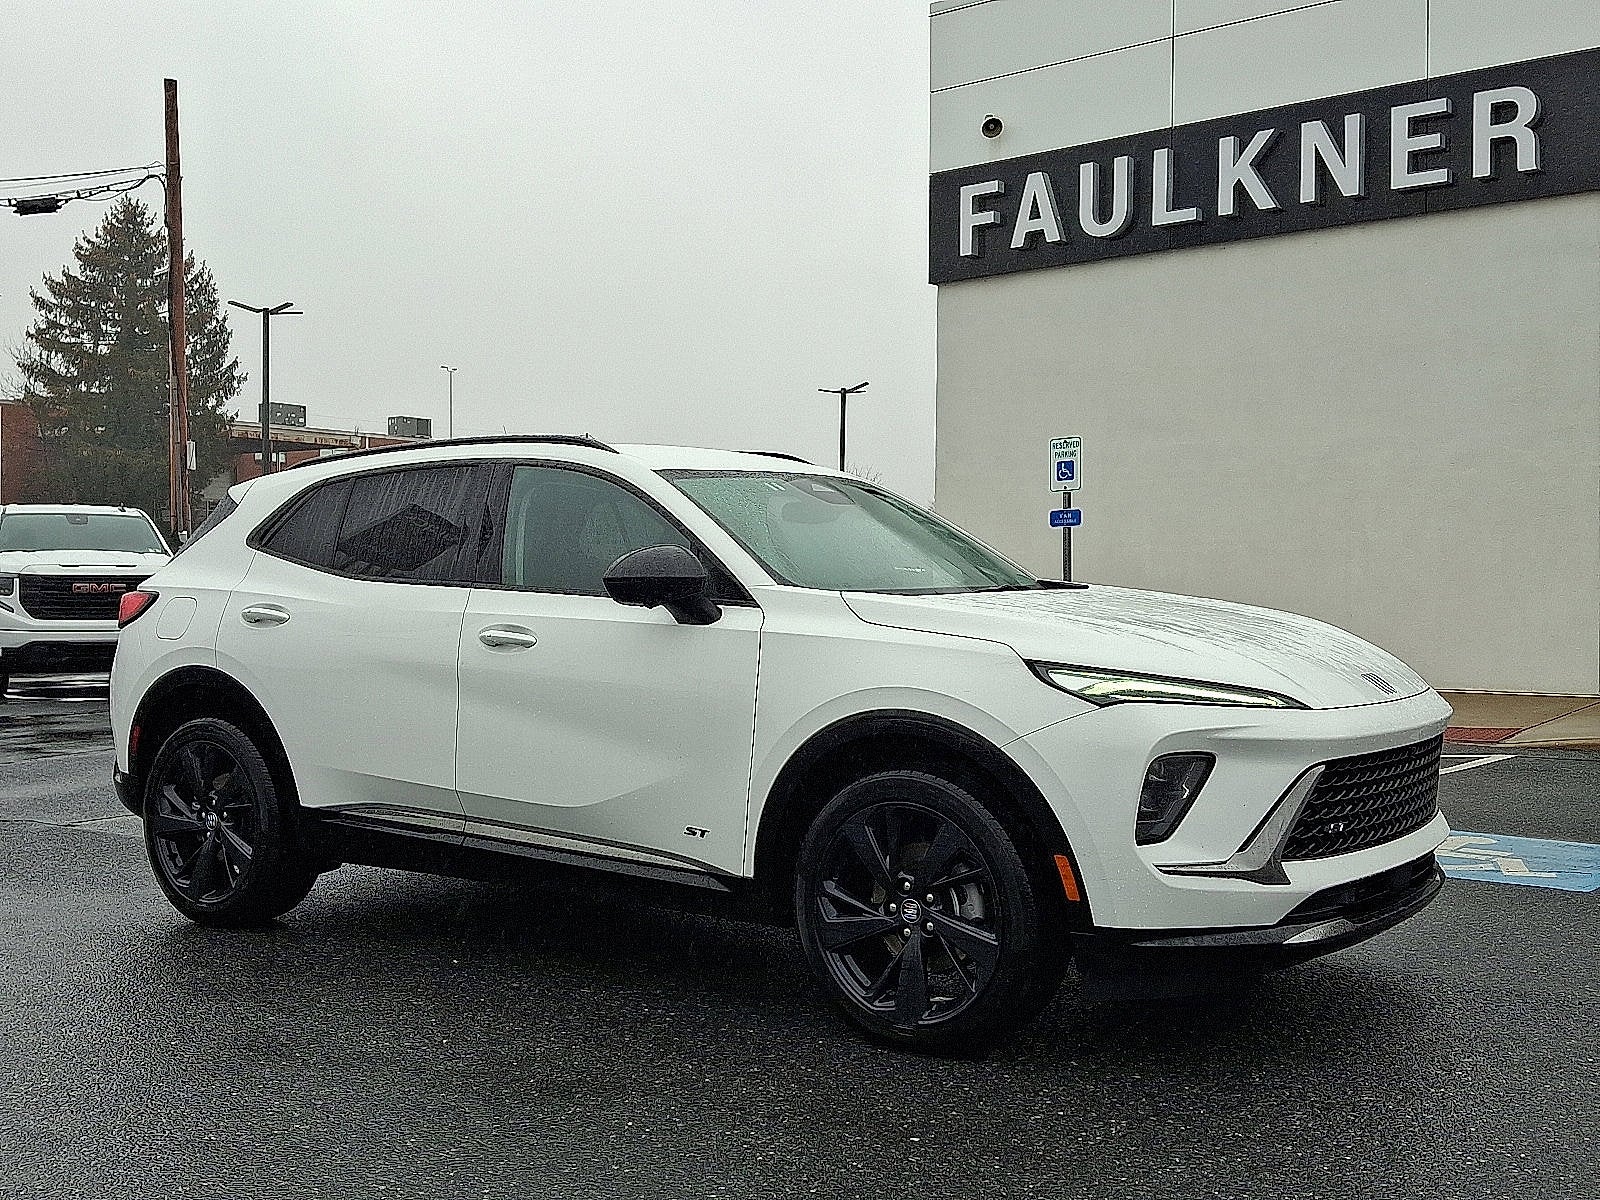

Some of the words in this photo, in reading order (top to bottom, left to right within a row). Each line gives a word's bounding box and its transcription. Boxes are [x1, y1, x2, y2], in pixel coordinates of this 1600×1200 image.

[958, 85, 1542, 258] FAULKNER
[1052, 440, 1080, 450] RESERVED
[1054, 450, 1077, 459] PARKING
[72, 583, 127, 593] GMC
[683, 826, 711, 839] ST
